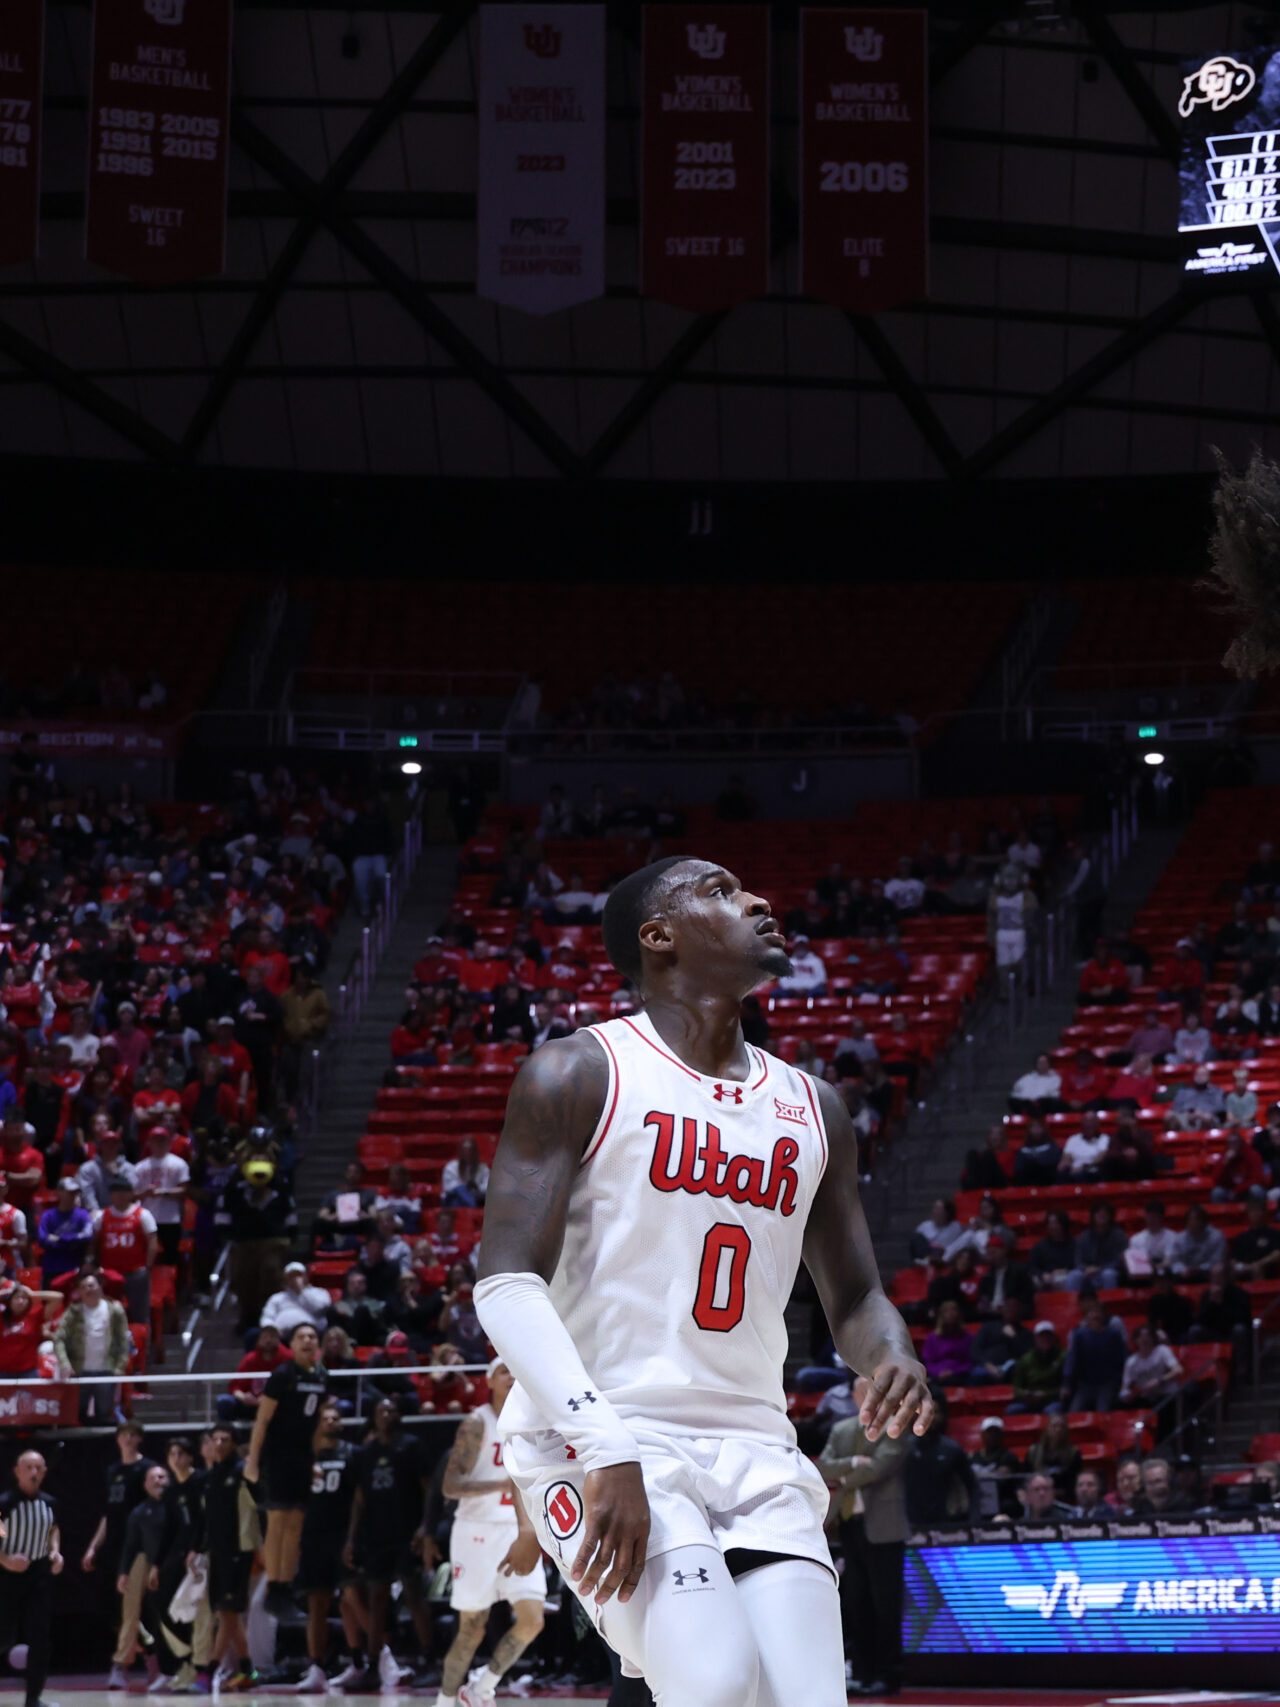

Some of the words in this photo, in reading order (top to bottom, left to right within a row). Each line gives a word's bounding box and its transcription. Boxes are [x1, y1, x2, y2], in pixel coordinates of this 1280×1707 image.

[137, 44, 187, 67] MEN'S
[109, 62, 211, 91] BASKETBALL
[674, 75, 743, 94] WOMEN'S
[508, 86, 576, 105] WOMEN'S
[661, 92, 753, 112] BASKETBALL
[829, 82, 900, 101] WOMEN'S
[99, 107, 155, 131] 1983
[160, 113, 220, 139] 2005
[495, 105, 586, 123] BASKETBALL
[816, 103, 911, 122] BASKETBALL
[0, 145, 28, 168] 81
[99, 130, 152, 154] 1991
[161, 137, 217, 161] 2015
[676, 141, 735, 164] 2001
[96, 152, 154, 177] 1996
[516, 154, 566, 172] 2023
[673, 167, 736, 190] 2023
[819, 161, 909, 193] 2006
[128, 205, 184, 228] SWEET
[146, 228, 166, 247] 16
[665, 236, 720, 256] SWEET
[727, 237, 745, 256] 16
[843, 238, 885, 257] ELITE
[644, 1110, 800, 1218] Utah
[692, 1222, 752, 1333] 0
[1133, 1578, 1268, 1611] AMERICA
